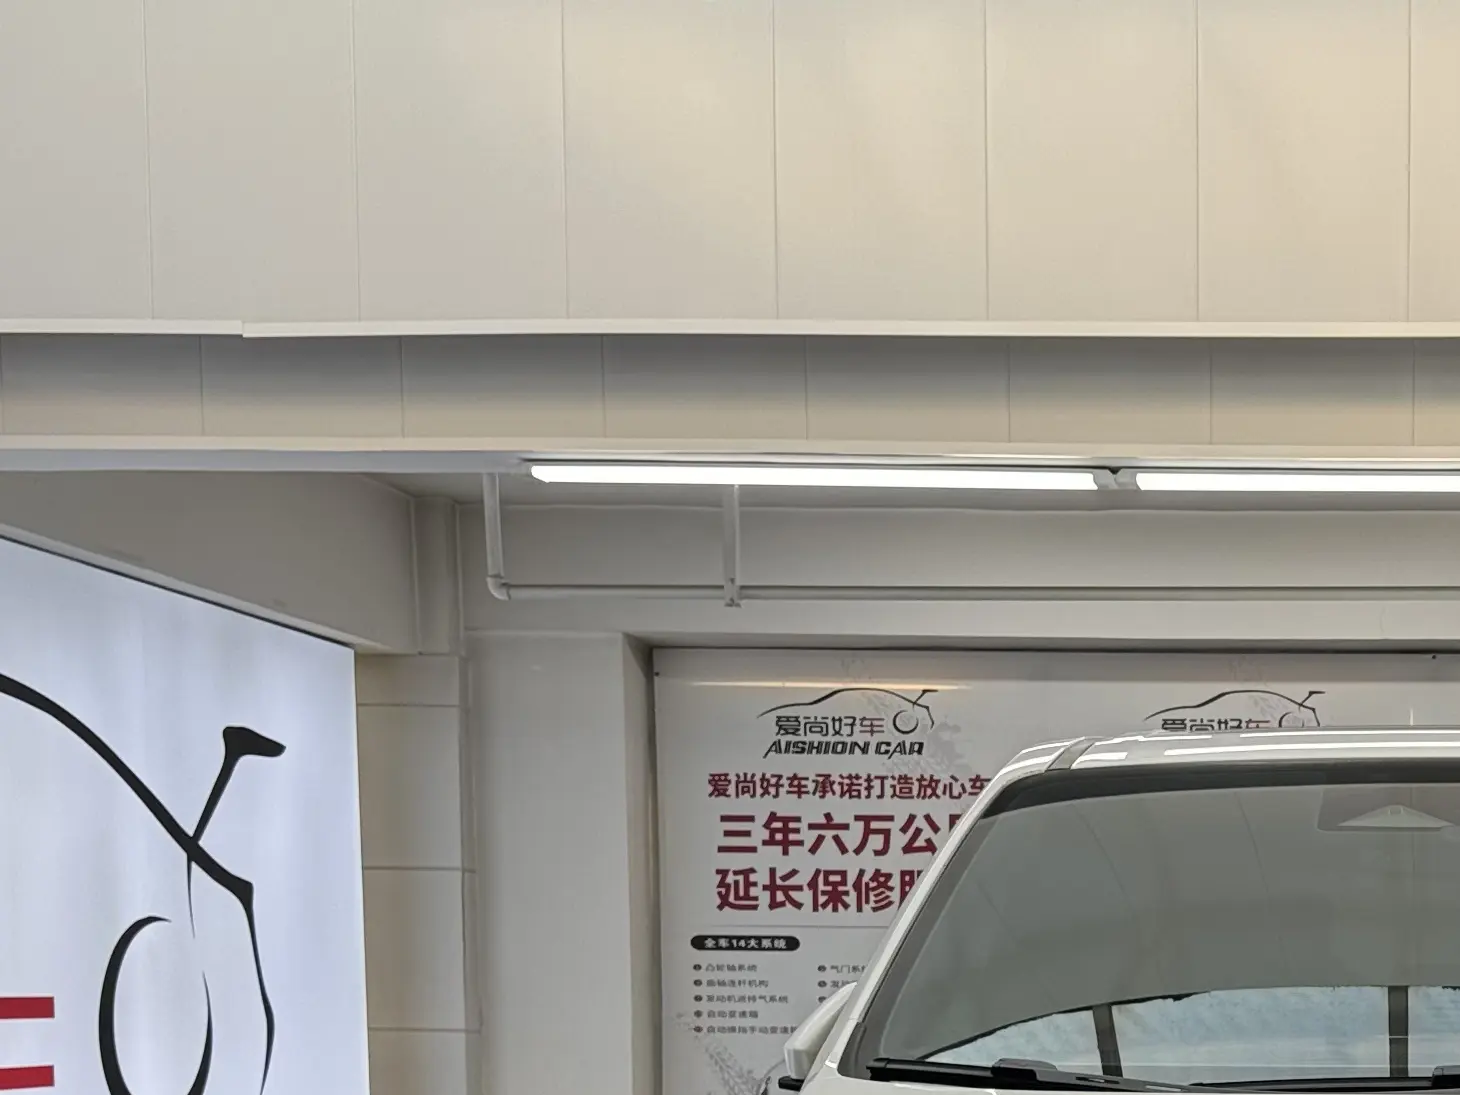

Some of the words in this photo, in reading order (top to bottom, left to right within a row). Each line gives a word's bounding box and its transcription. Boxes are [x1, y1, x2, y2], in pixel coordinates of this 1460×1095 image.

[775, 715, 885, 737] 爱尚好车
[763, 739, 870, 759] AISHION
[874, 739, 925, 759] CAR
[707, 772, 992, 800] 爱尚好车承诺打造放心车
[704, 937, 787, 949] 全车14大系统
